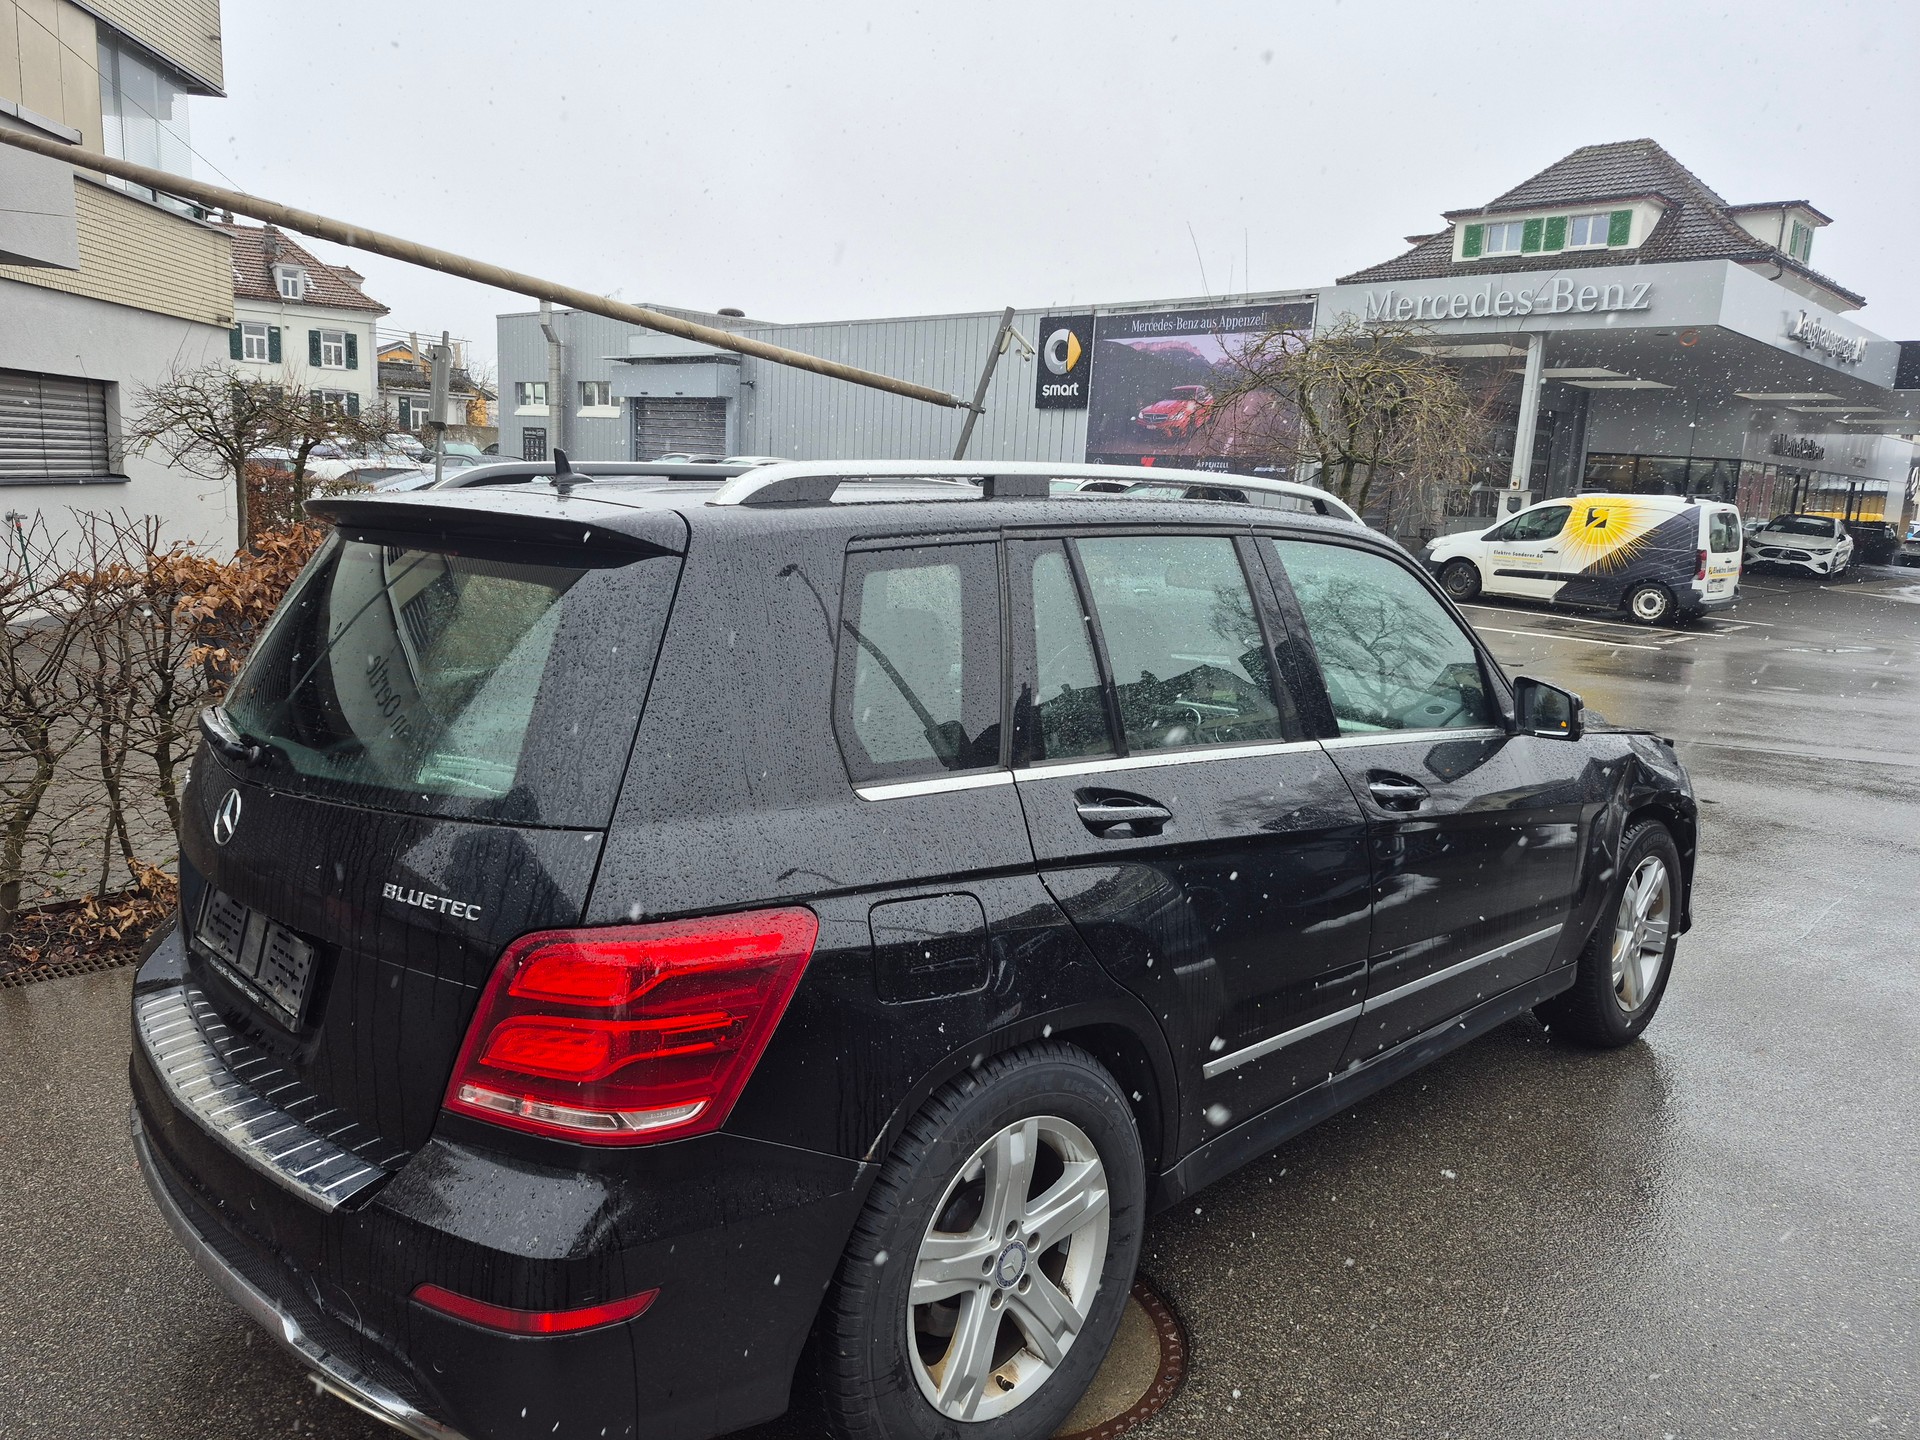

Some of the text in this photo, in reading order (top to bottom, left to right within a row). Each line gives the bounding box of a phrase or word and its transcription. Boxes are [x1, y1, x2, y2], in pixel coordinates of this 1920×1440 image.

[1363, 276, 1653, 322] Mercedes-Benz
[1131, 316, 1199, 332] Mercedes-Benz
[1200, 319, 1217, 329] aus
[1042, 382, 1079, 396] smart
[381, 882, 482, 922] BLUETEC
